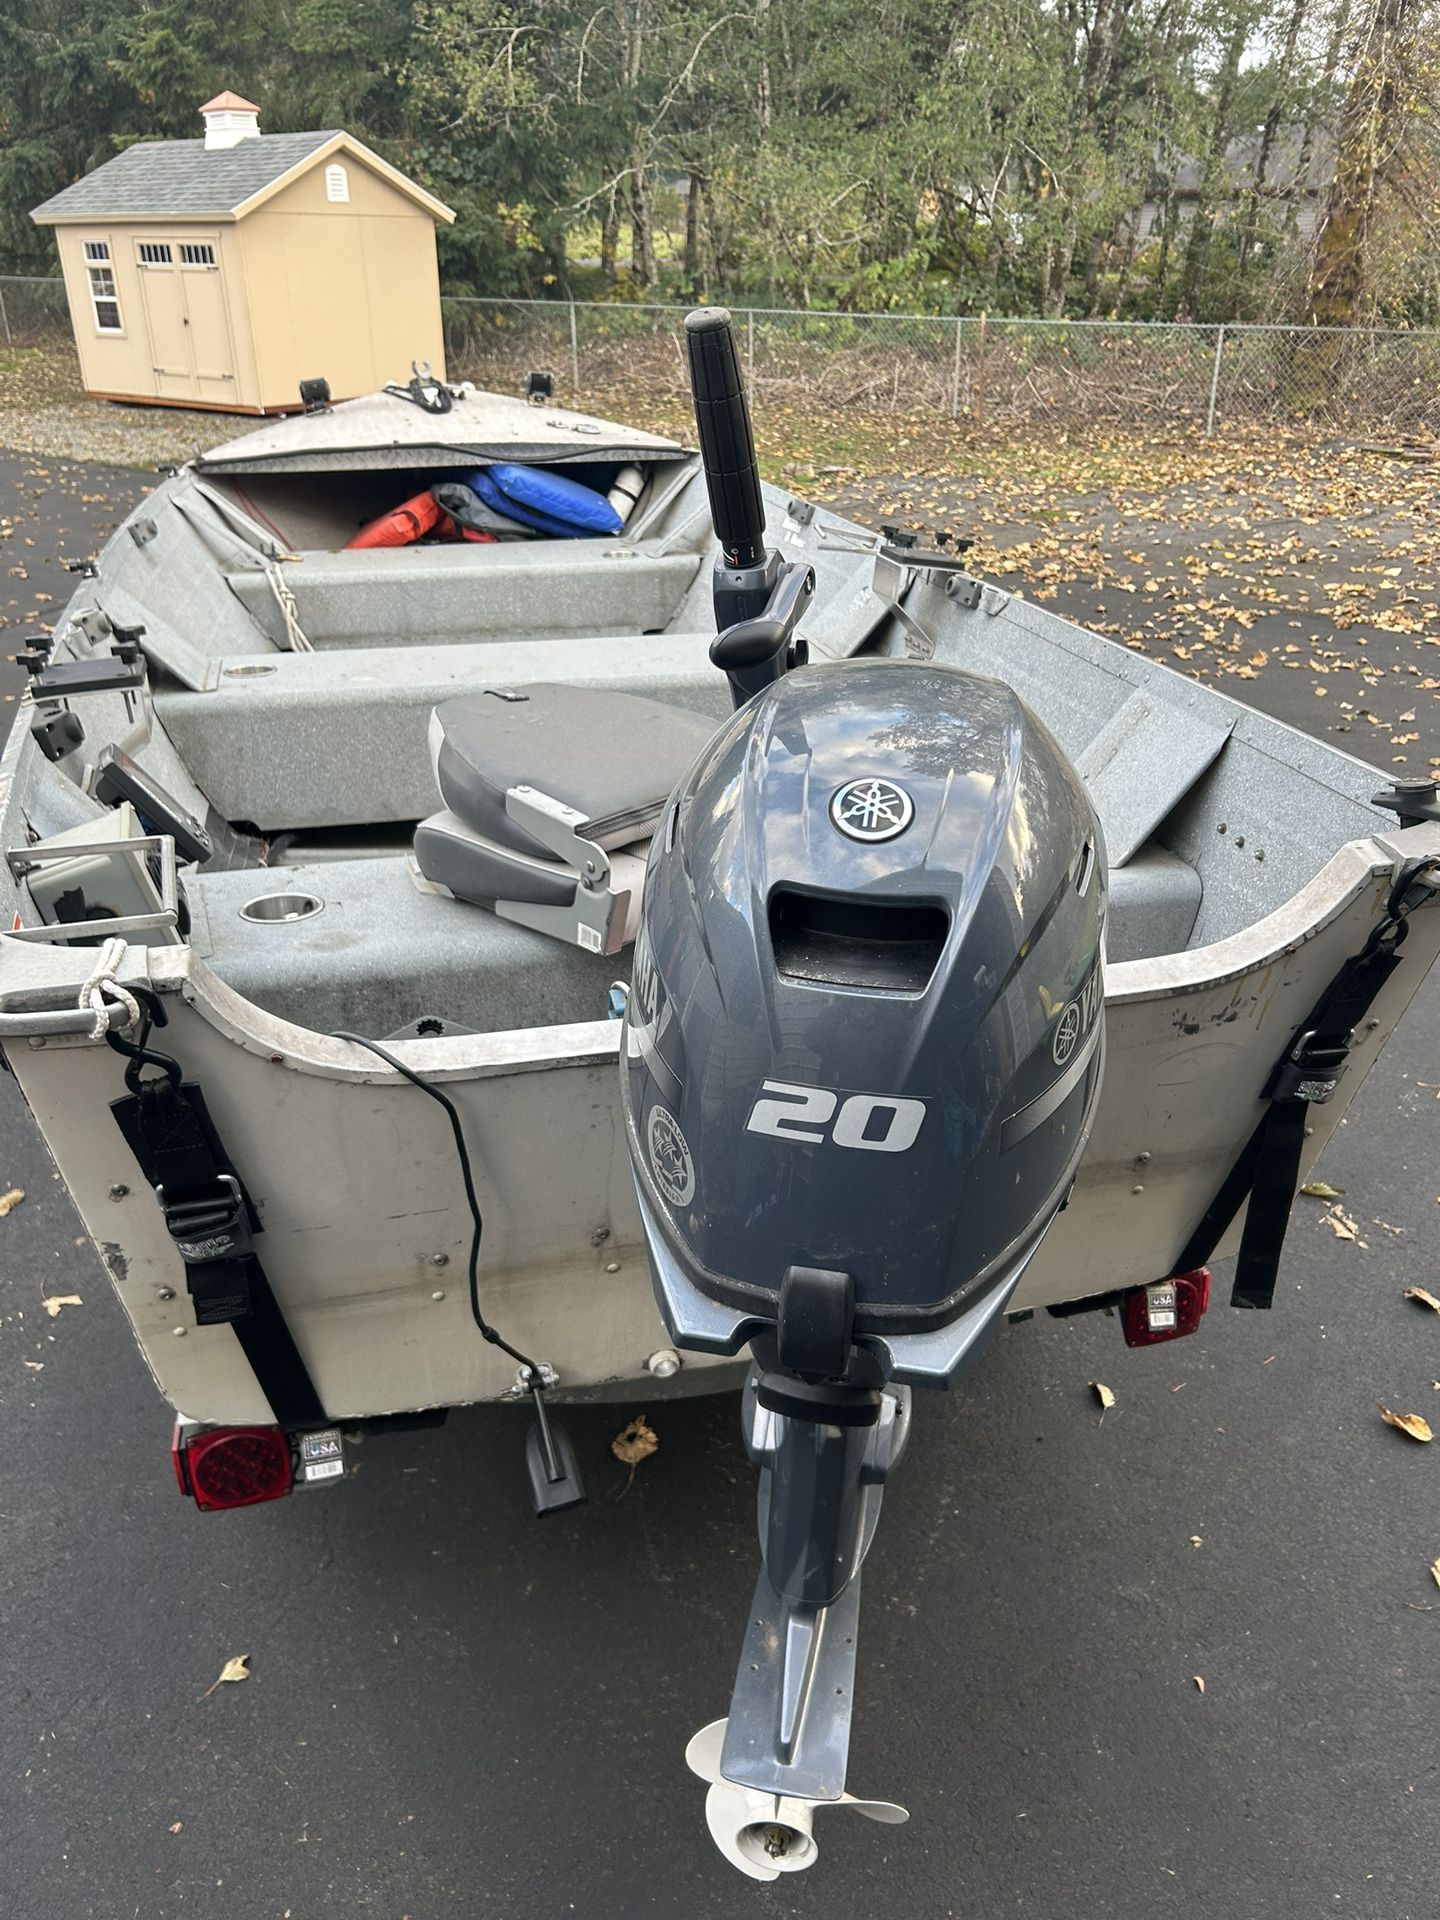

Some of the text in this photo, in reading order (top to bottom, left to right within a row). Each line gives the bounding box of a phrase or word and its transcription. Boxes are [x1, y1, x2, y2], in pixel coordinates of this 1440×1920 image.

[746, 1079, 927, 1152] 20
[1152, 1294, 1172, 1305] USA
[309, 1441, 340, 1456] USA
